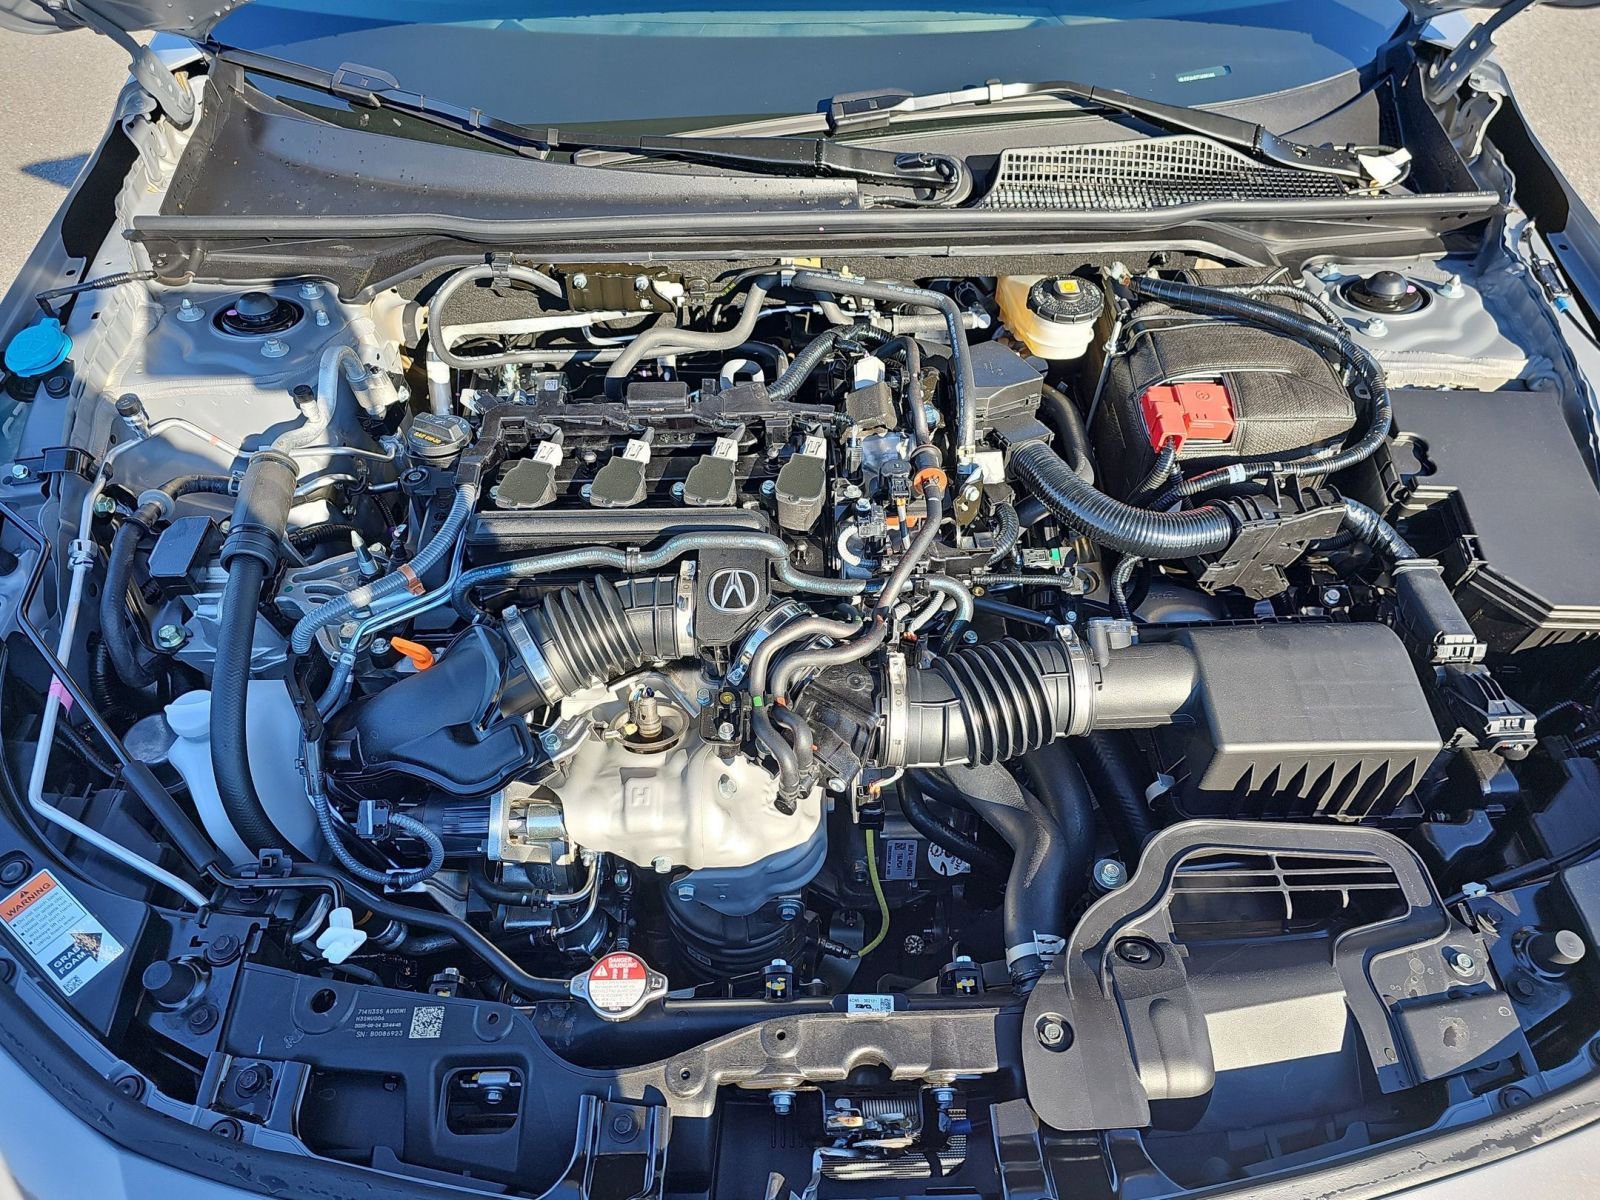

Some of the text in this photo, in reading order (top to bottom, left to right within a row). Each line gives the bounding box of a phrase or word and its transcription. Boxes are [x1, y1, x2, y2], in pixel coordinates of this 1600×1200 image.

[6, 882, 51, 916] WARNING
[54, 942, 80, 968] GRAB
[59, 951, 86, 974] FOAM
